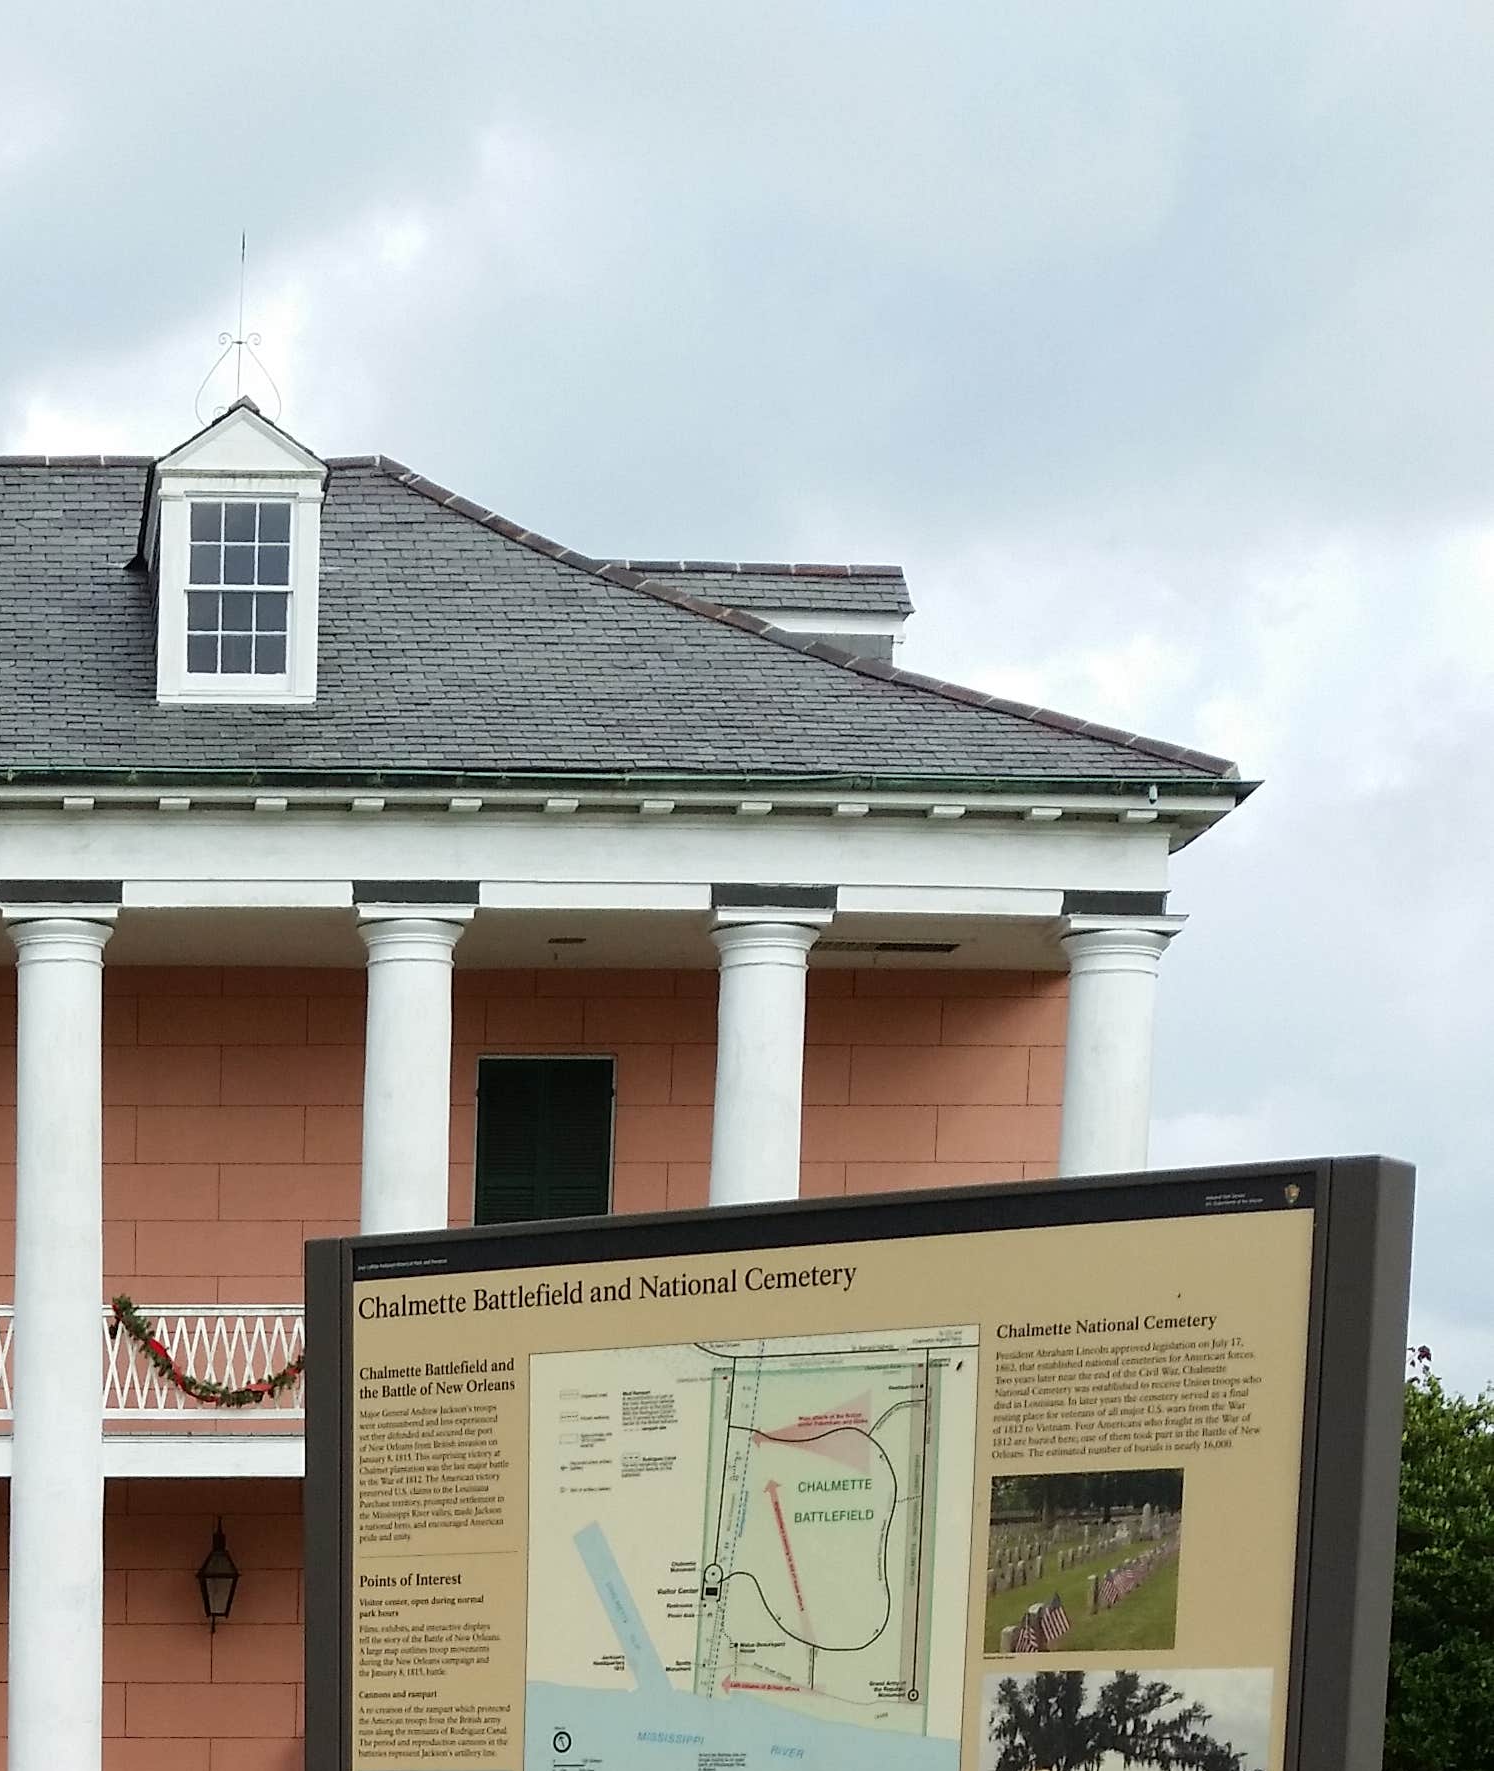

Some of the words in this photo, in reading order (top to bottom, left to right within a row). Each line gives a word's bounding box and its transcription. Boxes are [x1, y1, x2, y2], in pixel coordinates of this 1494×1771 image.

[358, 1290, 466, 1320] Chalmette
[474, 1282, 582, 1312] Battlefield
[590, 1278, 631, 1303] and
[640, 1271, 736, 1300] National
[744, 1263, 856, 1298] Cemetery
[997, 1320, 1071, 1338] Chalmette
[1076, 1316, 1139, 1335] National
[1143, 1313, 1214, 1335] Cemetery
[359, 1362, 421, 1380] Chalmette
[425, 1358, 488, 1376] Battlefield
[490, 1357, 514, 1373] and
[359, 1384, 378, 1400] the
[381, 1382, 417, 1398] Battle
[419, 1381, 432, 1396] of
[435, 1379, 463, 1395] New
[466, 1376, 515, 1394] Orleans
[798, 1479, 873, 1493] CHALMETTE
[794, 1509, 874, 1523] BATTLEFIELD
[359, 1575, 397, 1588] Points
[399, 1574, 412, 1587] of
[416, 1573, 461, 1586] Interest
[359, 1597, 383, 1606] Visitor
[410, 1598, 429, 1607] open
[430, 1596, 456, 1607] during
[456, 1595, 484, 1604] normal
[359, 1608, 376, 1619] park
[377, 1608, 399, 1617] hours
[359, 1690, 391, 1698] Cannons
[392, 1689, 407, 1698] and
[407, 1690, 437, 1700] rampart
[637, 1731, 705, 1745] MISSISSIPPI
[770, 1745, 805, 1759] RIVER
